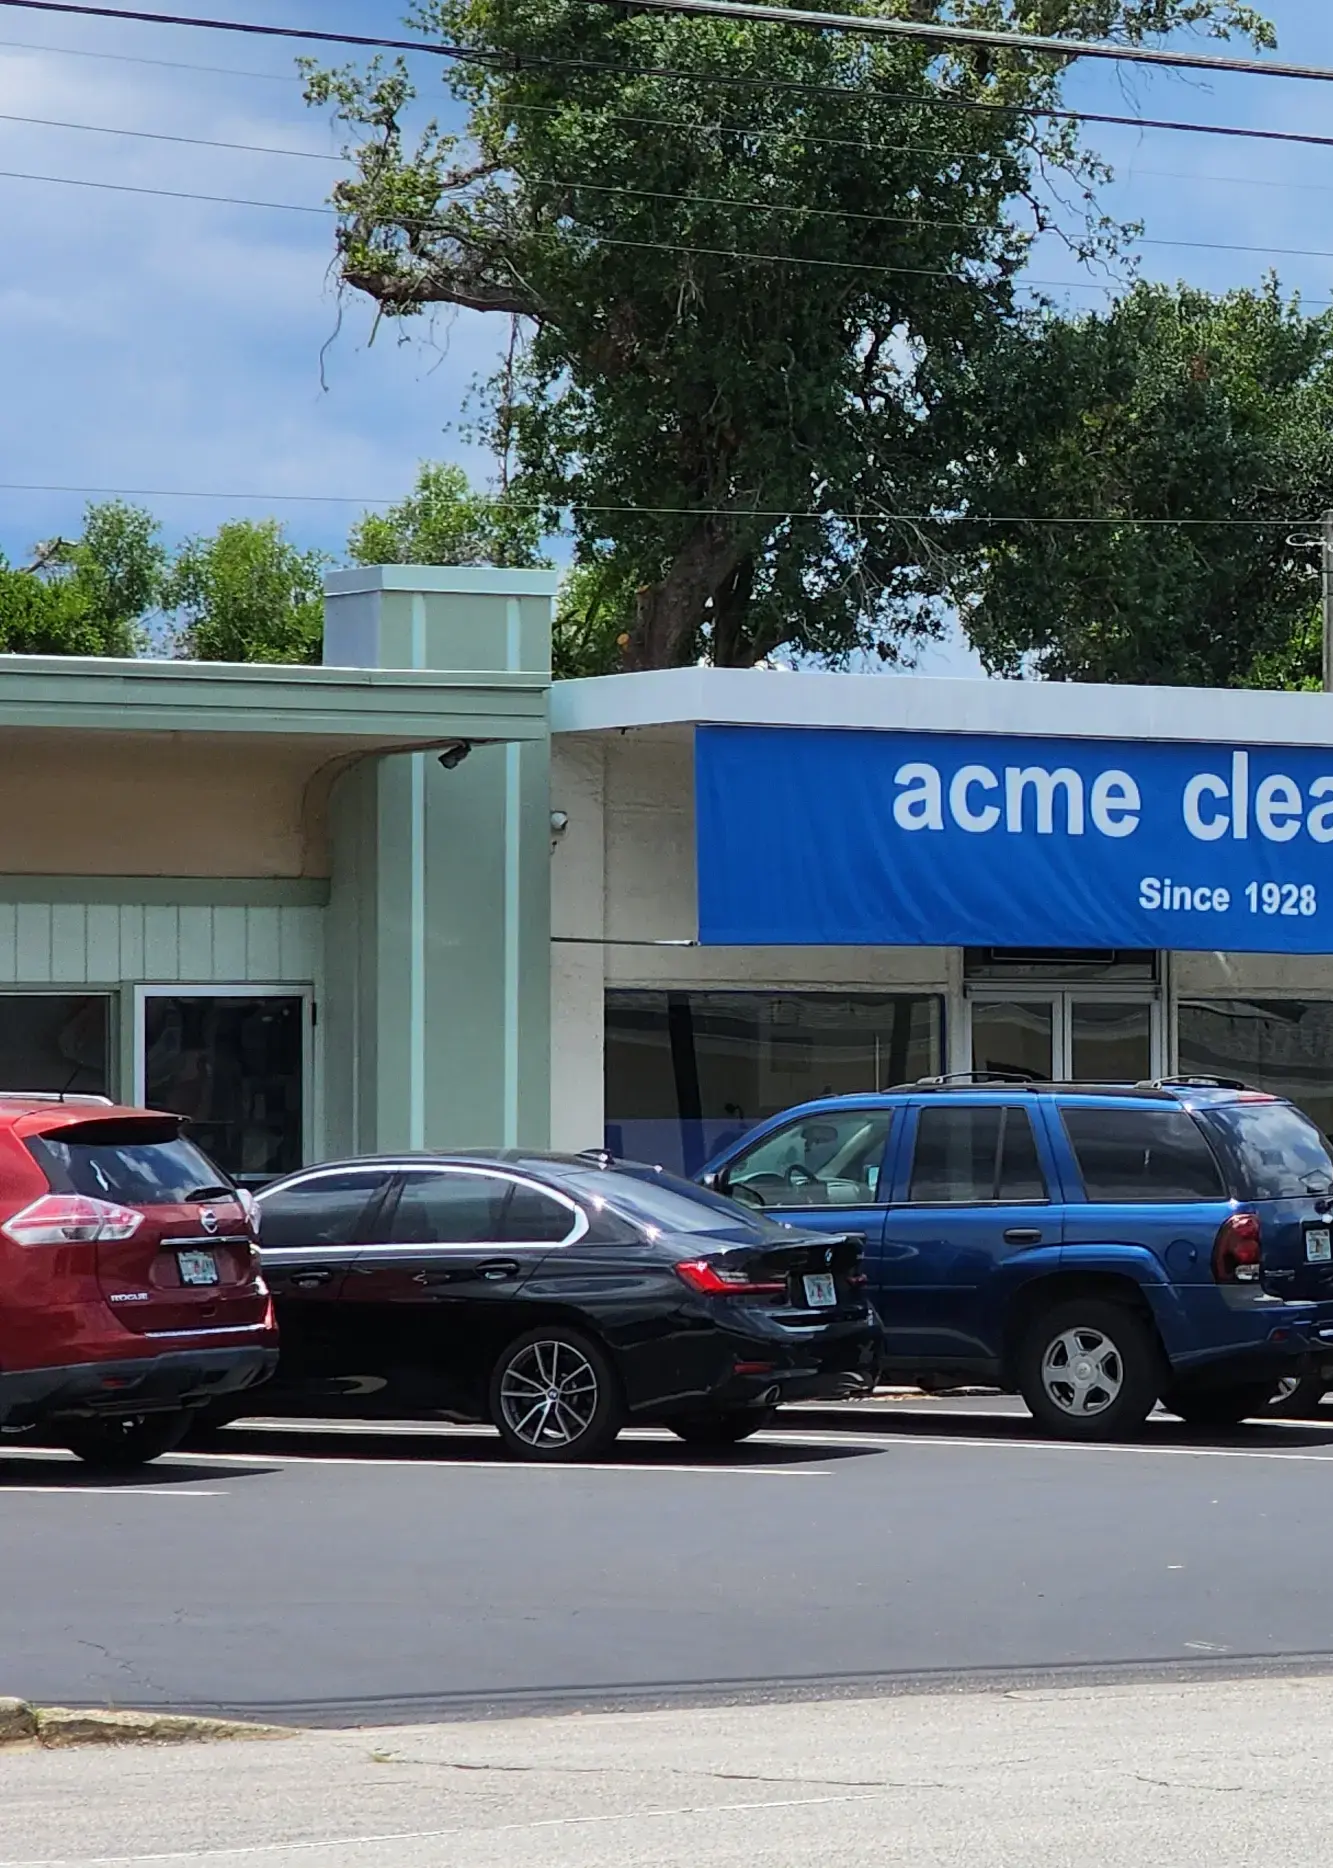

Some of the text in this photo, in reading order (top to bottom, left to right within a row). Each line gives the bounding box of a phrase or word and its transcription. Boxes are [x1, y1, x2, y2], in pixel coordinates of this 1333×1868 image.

[893, 761, 1141, 837] acme
[1139, 877, 1317, 917] Since 1928
[110, 1292, 149, 1302] ROGUE
